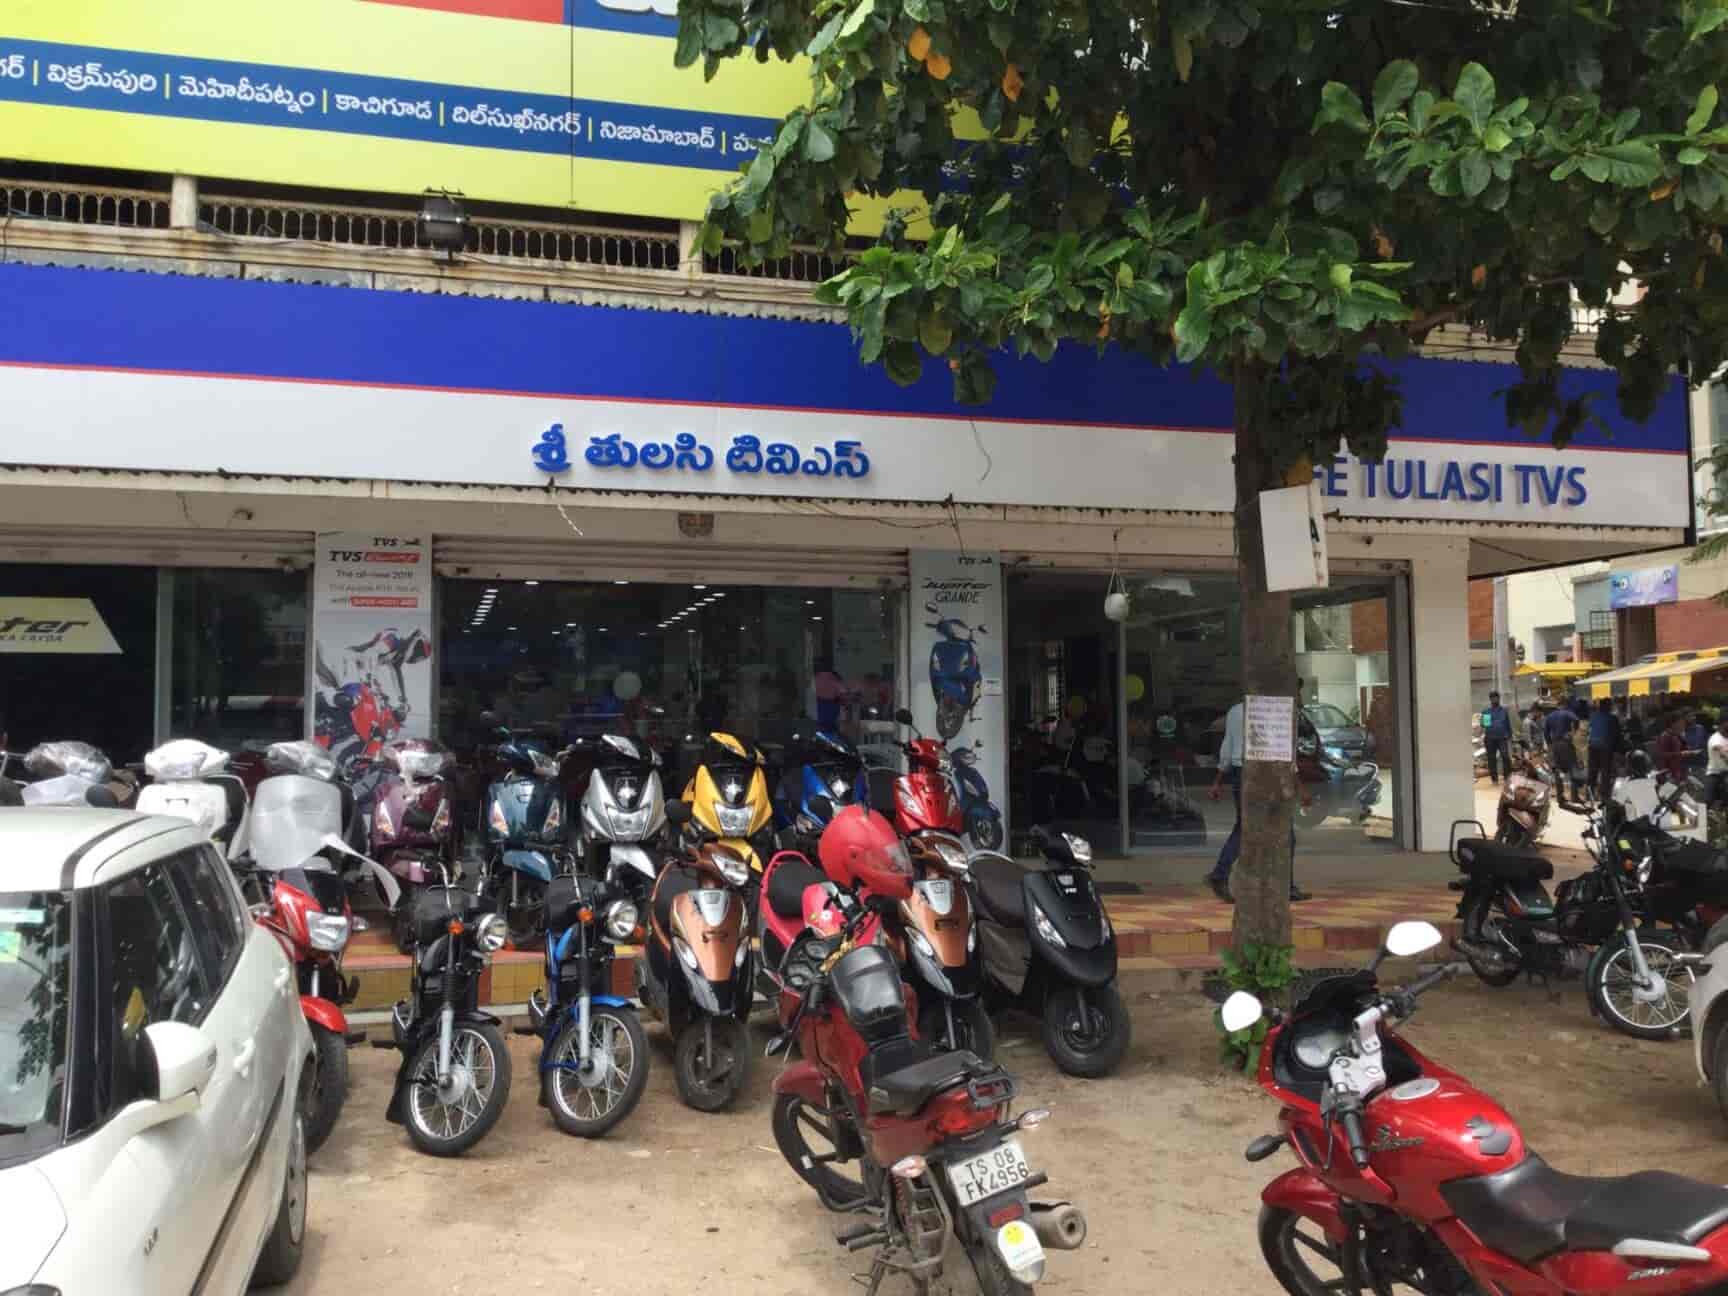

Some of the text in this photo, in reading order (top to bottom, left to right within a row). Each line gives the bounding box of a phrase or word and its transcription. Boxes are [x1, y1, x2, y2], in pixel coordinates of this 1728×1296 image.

[335, 92, 432, 120] కాచిగూడ
[600, 124, 715, 149] నిజామాబాద్
[532, 423, 870, 478] శ్రీ తులసి టివిఎస్
[1364, 458, 1502, 502] TULASI
[1514, 464, 1587, 506] TVS
[329, 551, 362, 562] TVS
[373, 537, 398, 546] TVS
[966, 1148, 1016, 1180] TS 08
